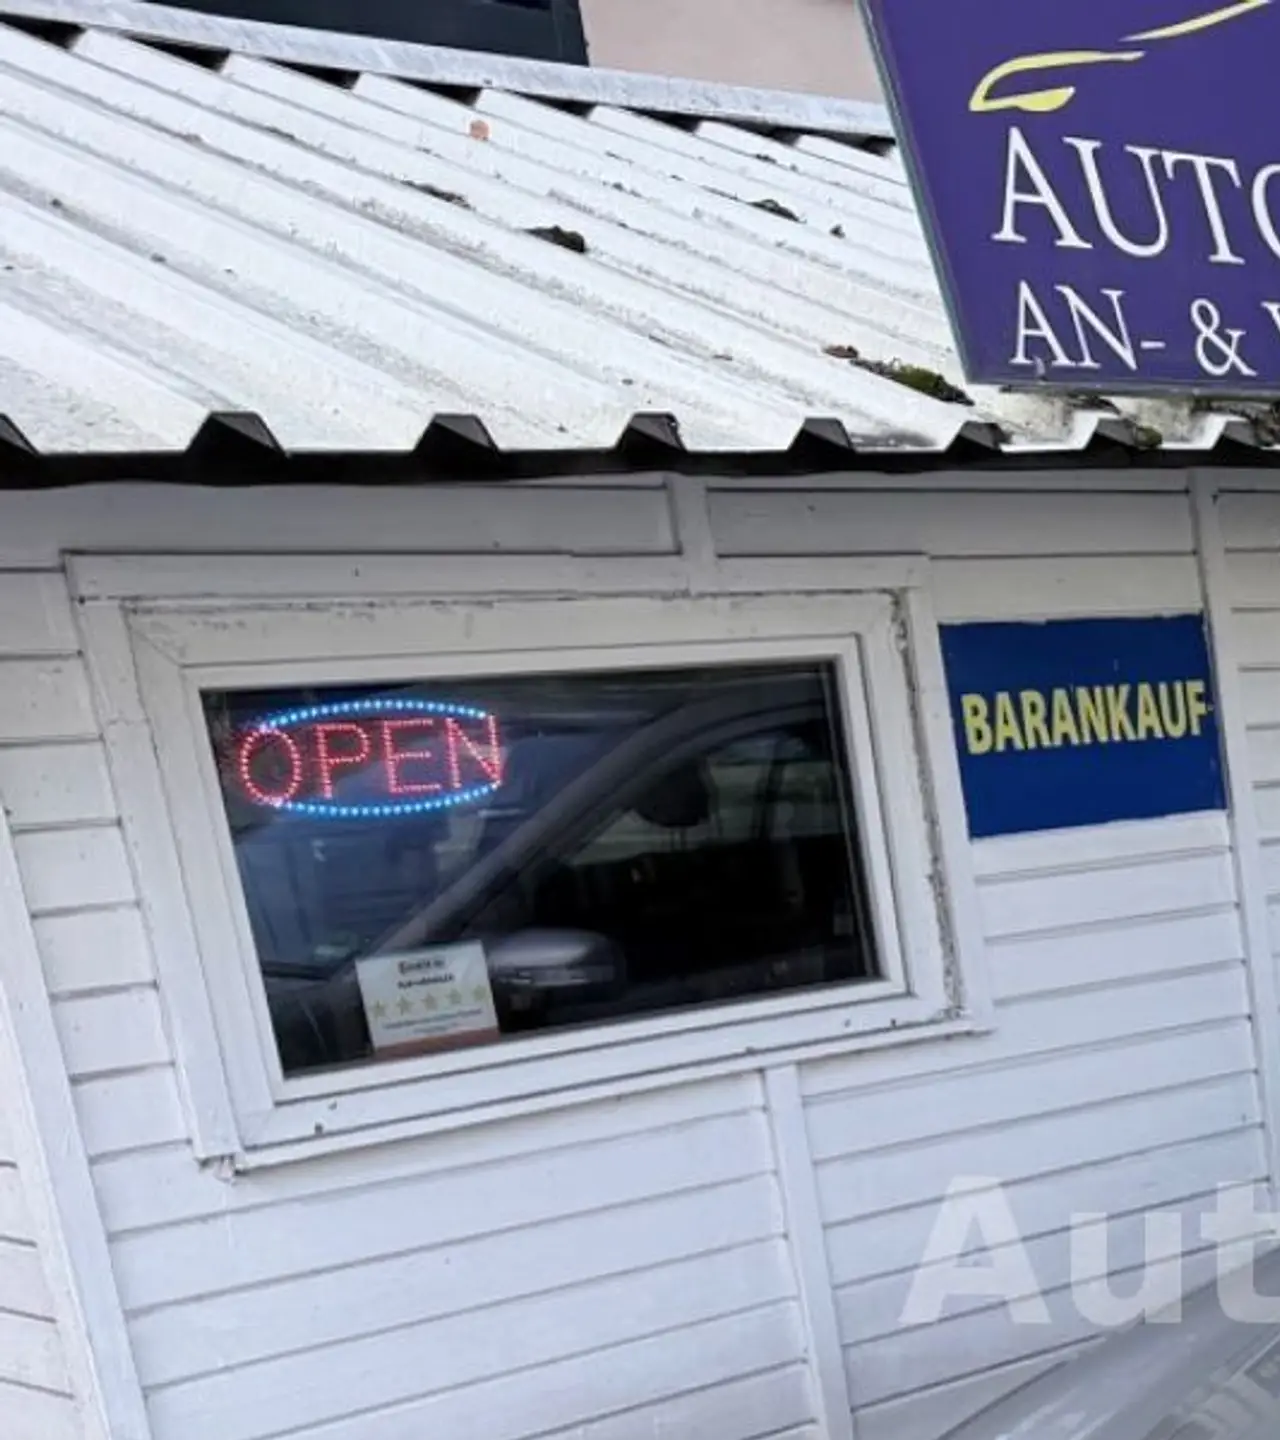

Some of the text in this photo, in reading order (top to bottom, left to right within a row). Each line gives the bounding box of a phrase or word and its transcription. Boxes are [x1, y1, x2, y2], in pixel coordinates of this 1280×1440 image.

[1010, 280, 1166, 370] AN-
[1190, 298, 1256, 376] &
[238, 711, 503, 807] OPEN
[960, 679, 1208, 755] BARANKAUF
